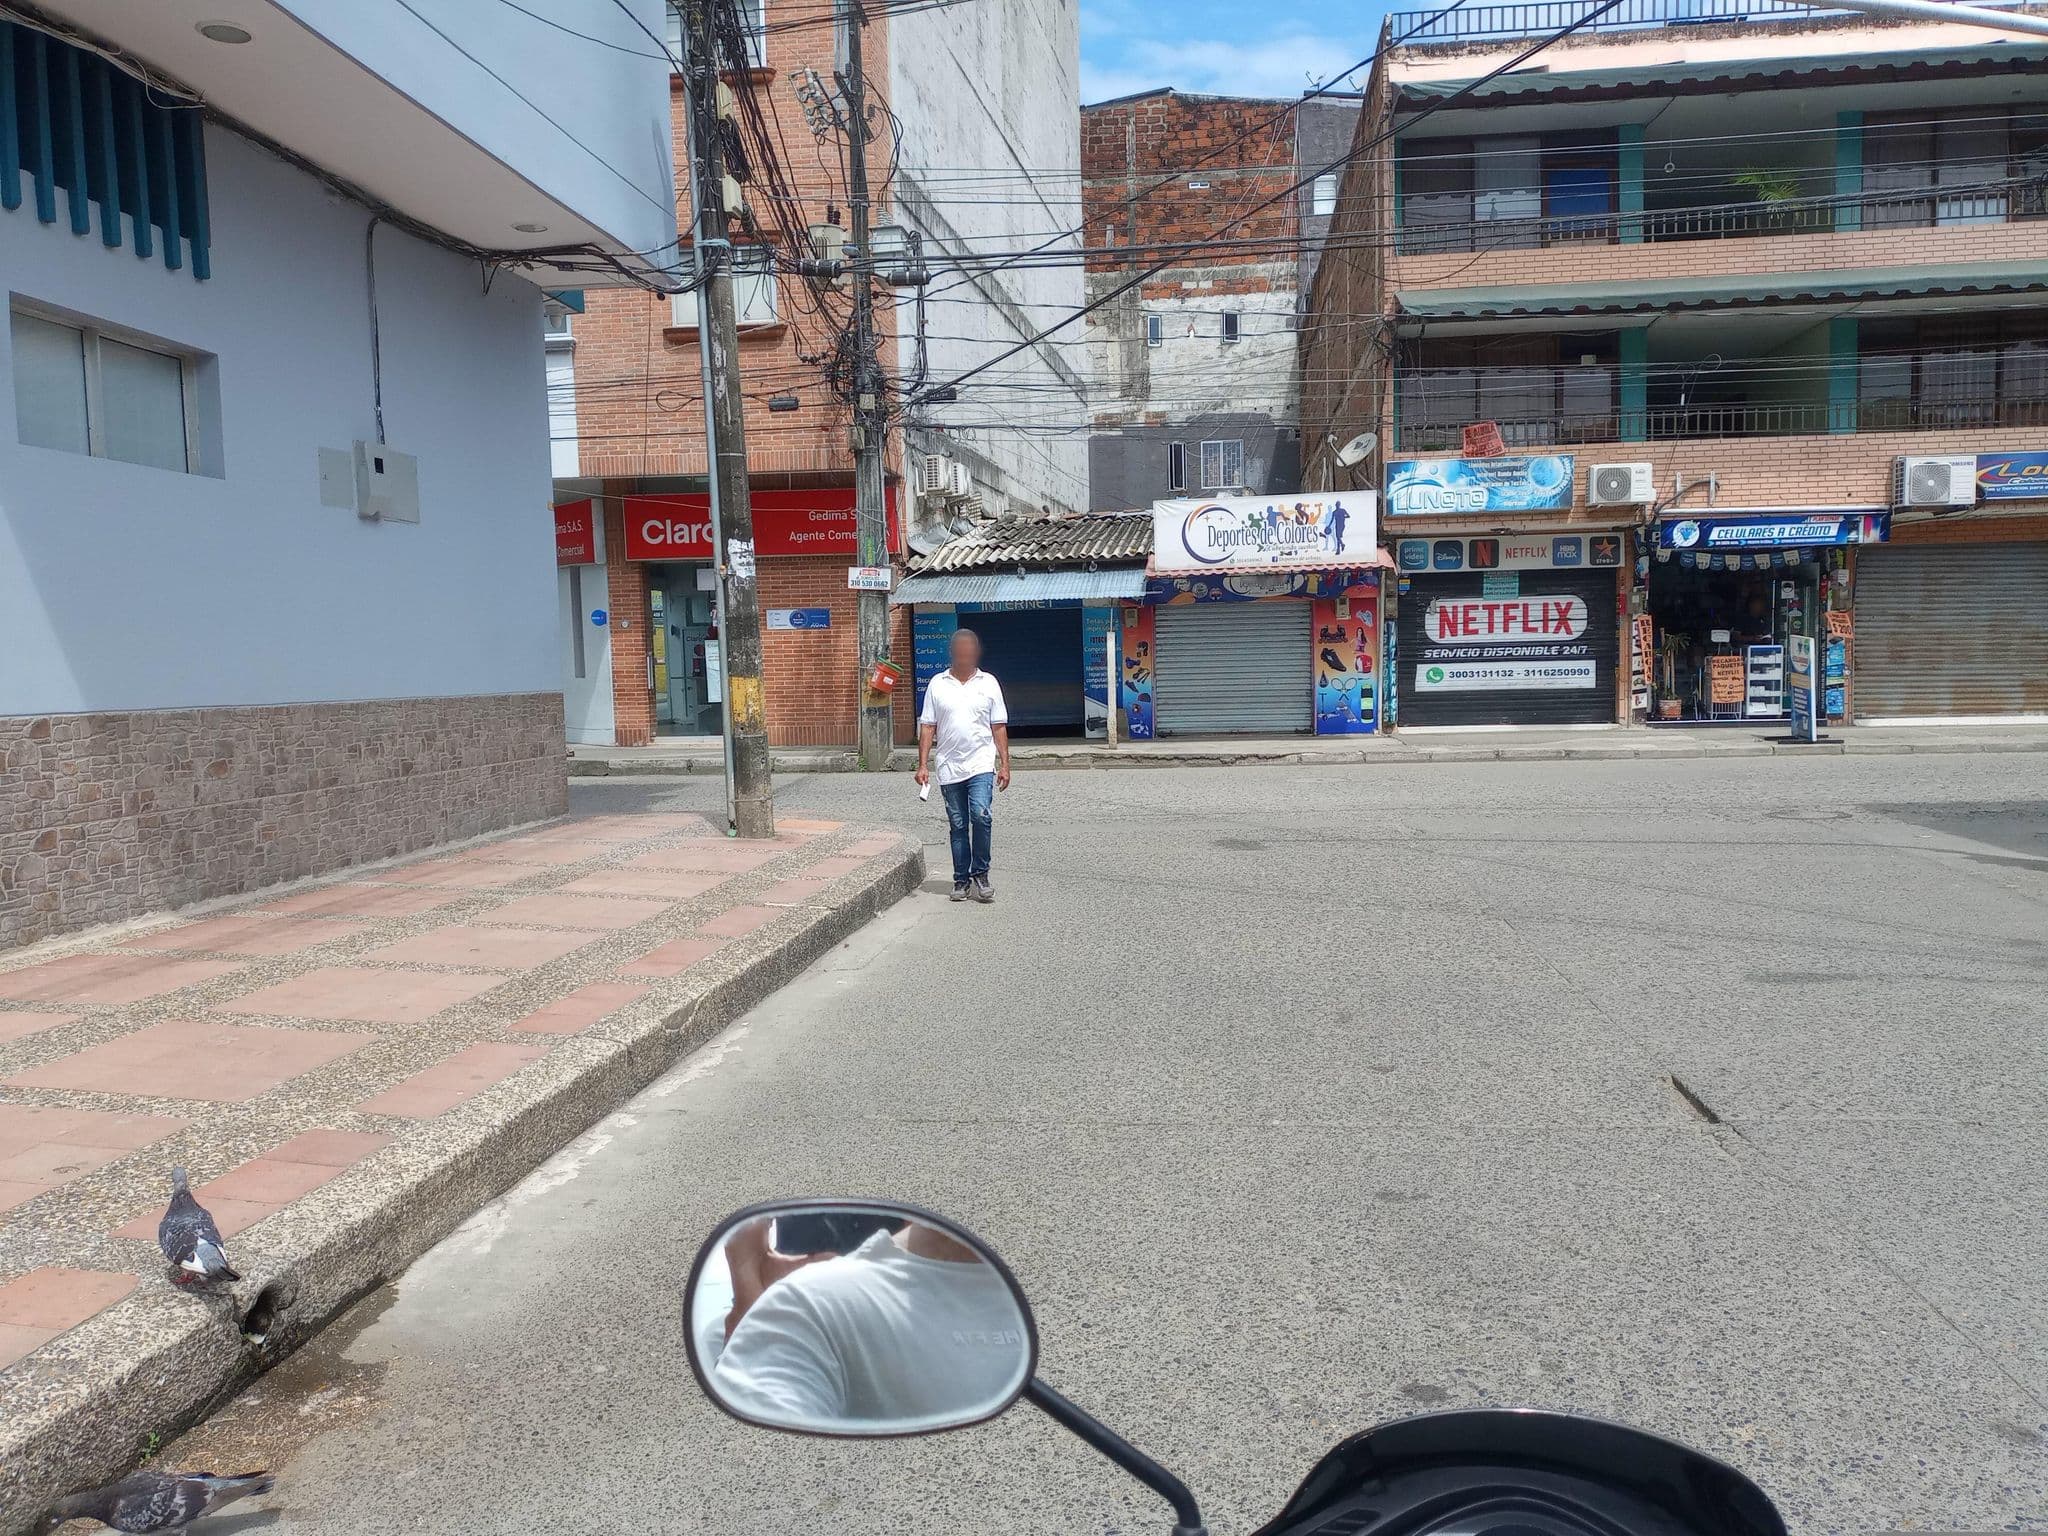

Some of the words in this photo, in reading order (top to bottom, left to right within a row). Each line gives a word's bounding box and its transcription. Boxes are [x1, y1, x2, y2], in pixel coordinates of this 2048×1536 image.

[1998, 461, 2048, 477] Lo
[809, 511, 848, 522] Gedima
[789, 531, 826, 544] Agente
[828, 531, 858, 541] Come
[1208, 525, 1257, 552] Deportes
[1259, 524, 1274, 546] de
[1276, 523, 1318, 545] Colores
[1718, 527, 1775, 539] CELULARES
[1778, 527, 1785, 537] A
[557, 544, 585, 557] Comercial
[1404, 546, 1425, 554] prime
[1405, 552, 1425, 560] video
[1505, 547, 1548, 560] NETFLIX
[1557, 551, 1578, 559] max
[1439, 601, 1574, 639] NETFLIX
[1424, 647, 1480, 658] SERVICIO
[1483, 646, 1560, 657] DISPONIBLE
[1563, 646, 1588, 655] 24/7
[916, 662, 934, 670] Hojas
[1448, 669, 1514, 679] 3003131132
[1523, 668, 1590, 678] 3116250990
